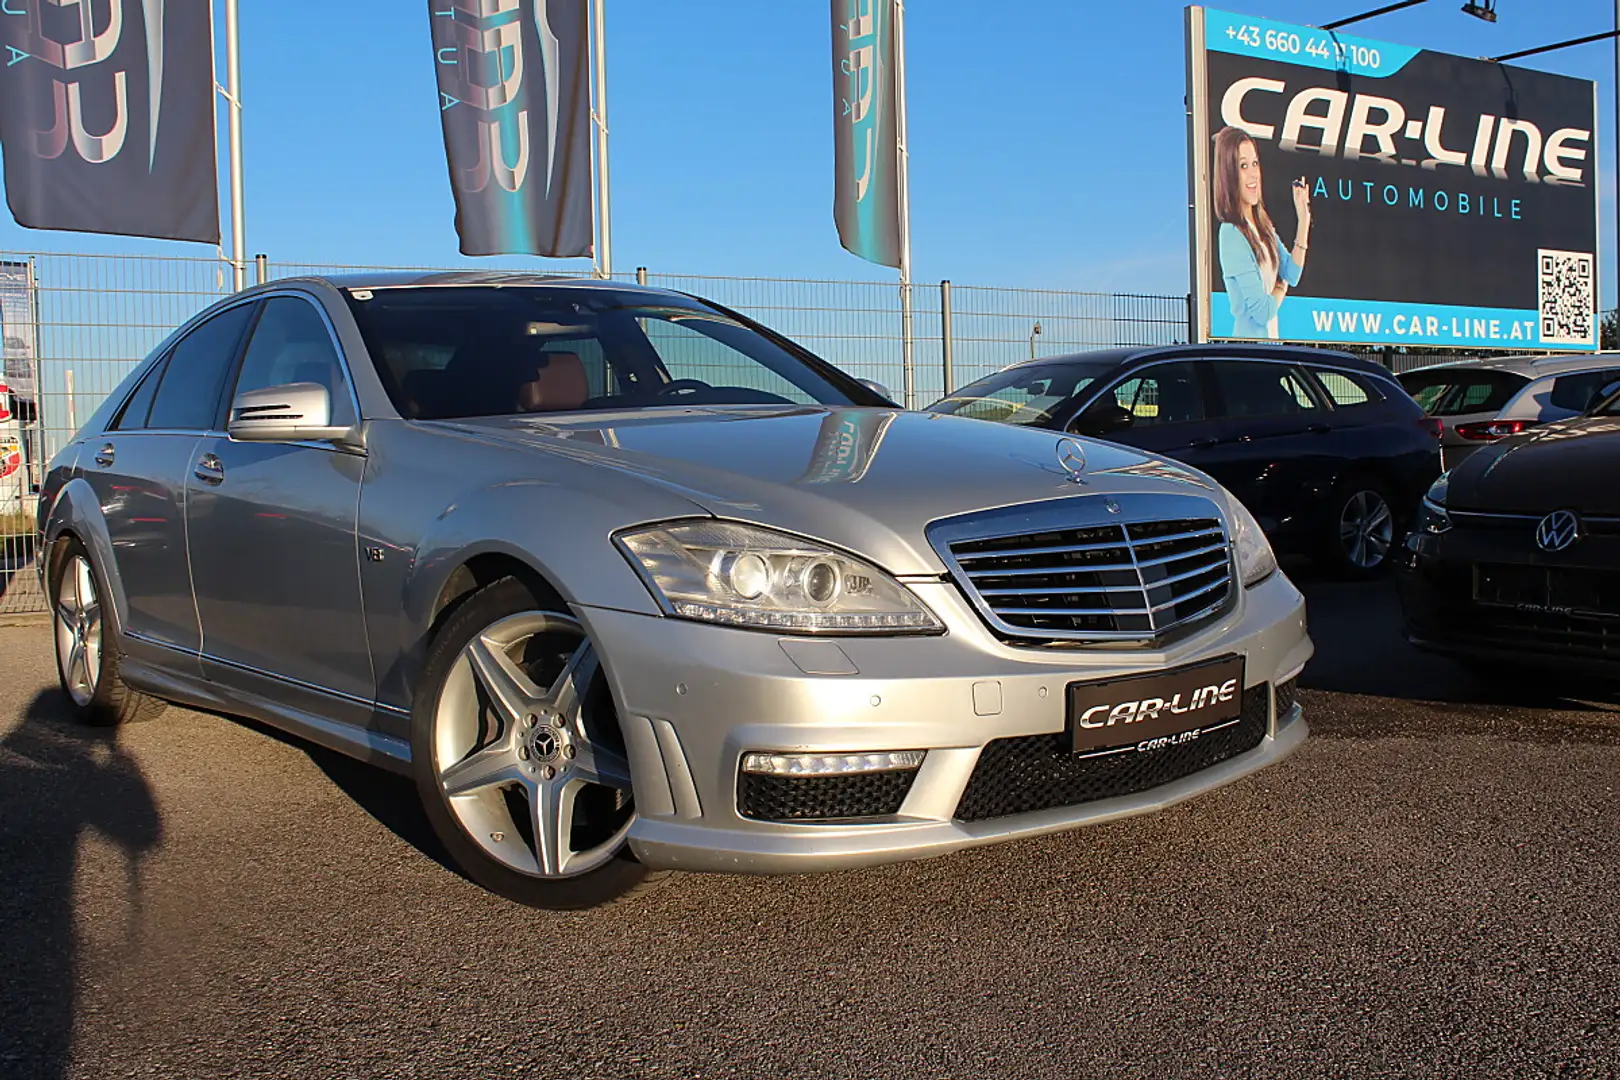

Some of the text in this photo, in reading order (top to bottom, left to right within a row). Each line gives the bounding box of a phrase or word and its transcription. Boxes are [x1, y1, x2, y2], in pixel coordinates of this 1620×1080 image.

[1225, 25, 1261, 47] +43
[1265, 30, 1300, 54] 660
[1305, 37, 1330, 59] 44
[1350, 46, 1381, 68] 100
[1313, 176, 1522, 220] AUTOMOBILE
[1311, 310, 1535, 340] WWW.CAR-LINE.AT
